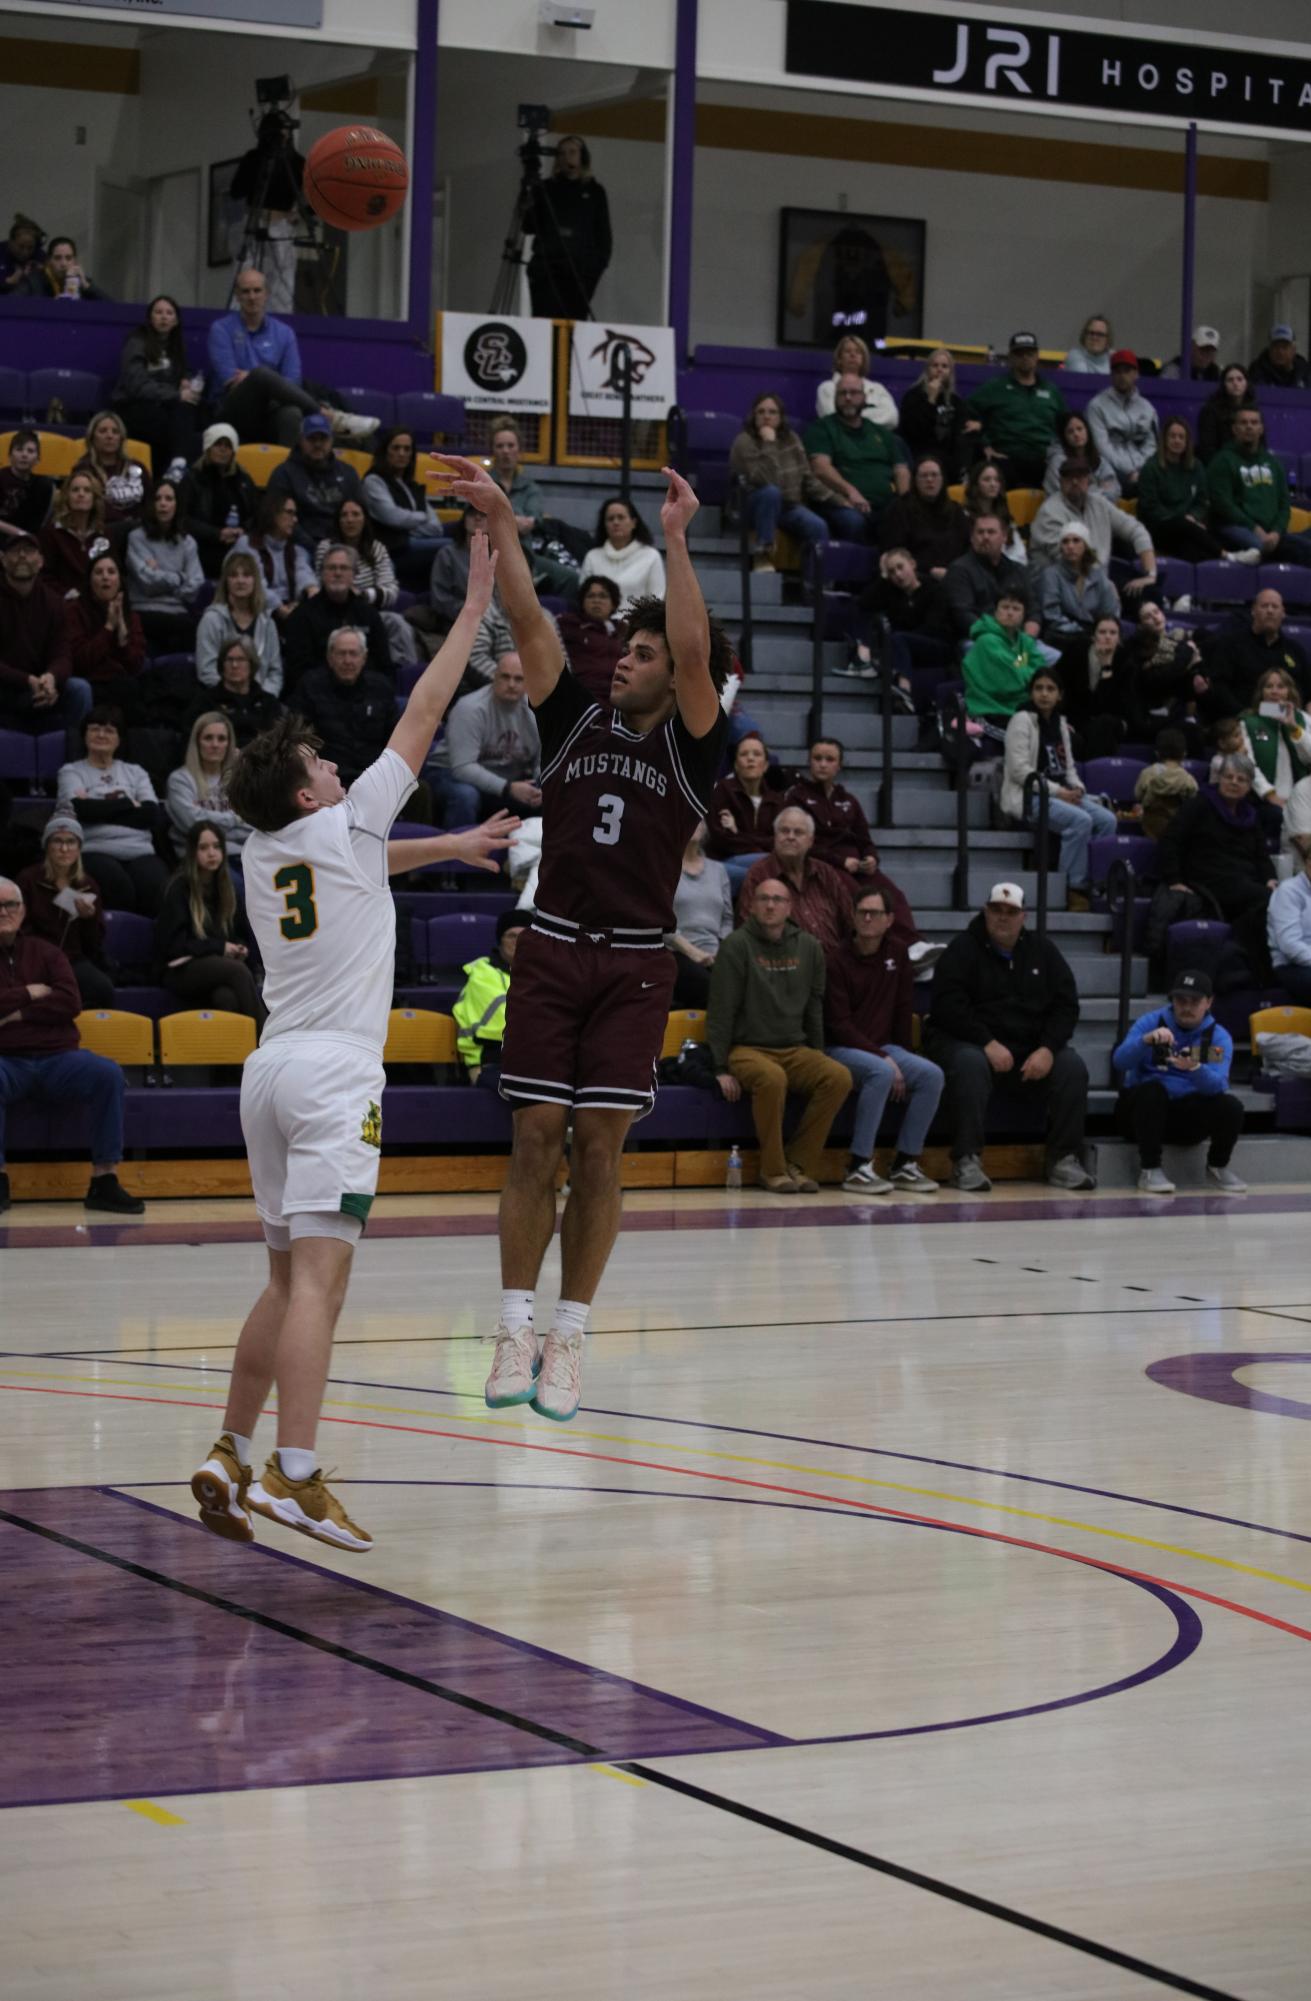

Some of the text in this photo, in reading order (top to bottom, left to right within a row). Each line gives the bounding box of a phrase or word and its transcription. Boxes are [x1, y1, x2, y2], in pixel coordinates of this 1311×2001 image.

[932, 24, 1060, 96] JRI
[473, 395, 505, 404] CENTRAL
[629, 393, 665, 402] ANTHERS
[564, 753, 668, 797] MUSTANGS
[592, 793, 625, 846] 3
[272, 861, 319, 942] 3
